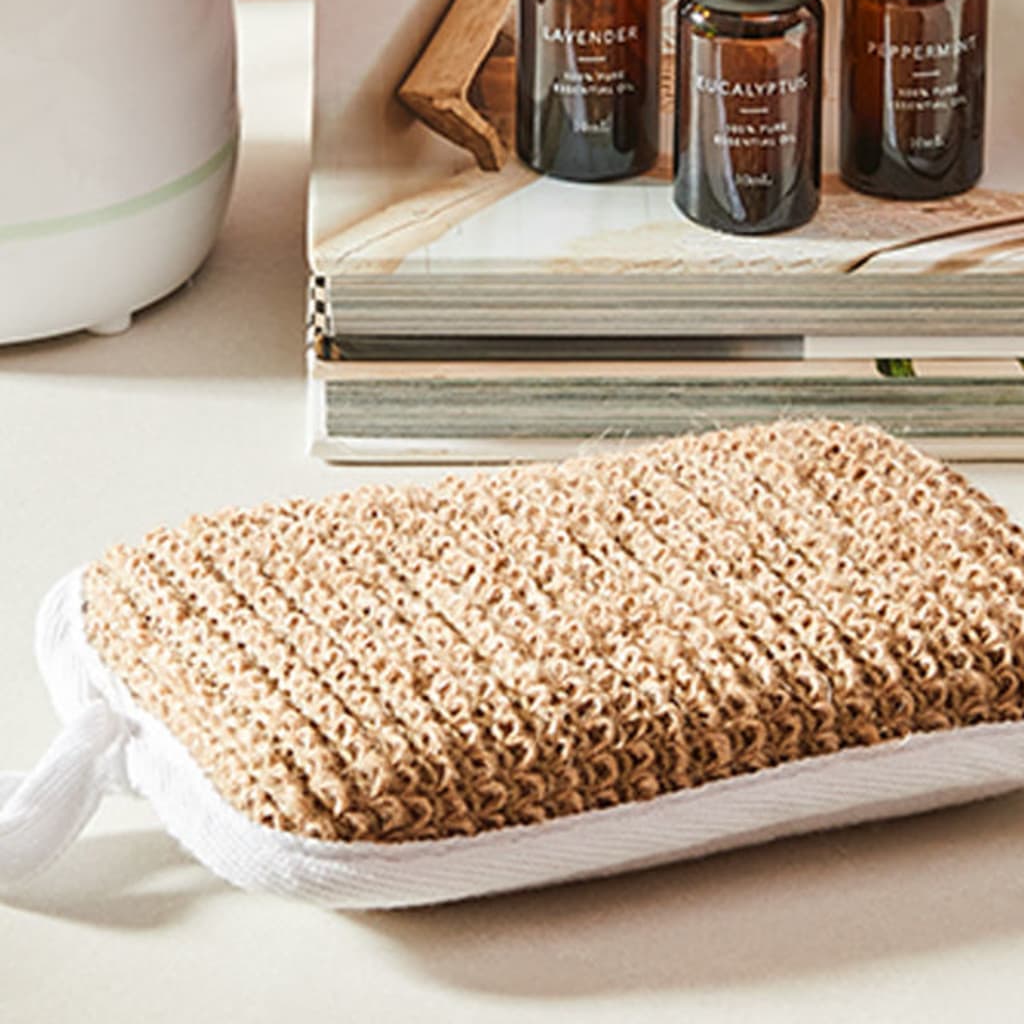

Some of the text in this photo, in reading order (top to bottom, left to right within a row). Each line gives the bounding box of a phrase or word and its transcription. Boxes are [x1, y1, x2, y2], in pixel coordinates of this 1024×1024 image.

[542, 25, 639, 45] LAVENDER
[867, 34, 977, 60] PEPPERMINT
[697, 73, 808, 97] EUCALYPTUS
